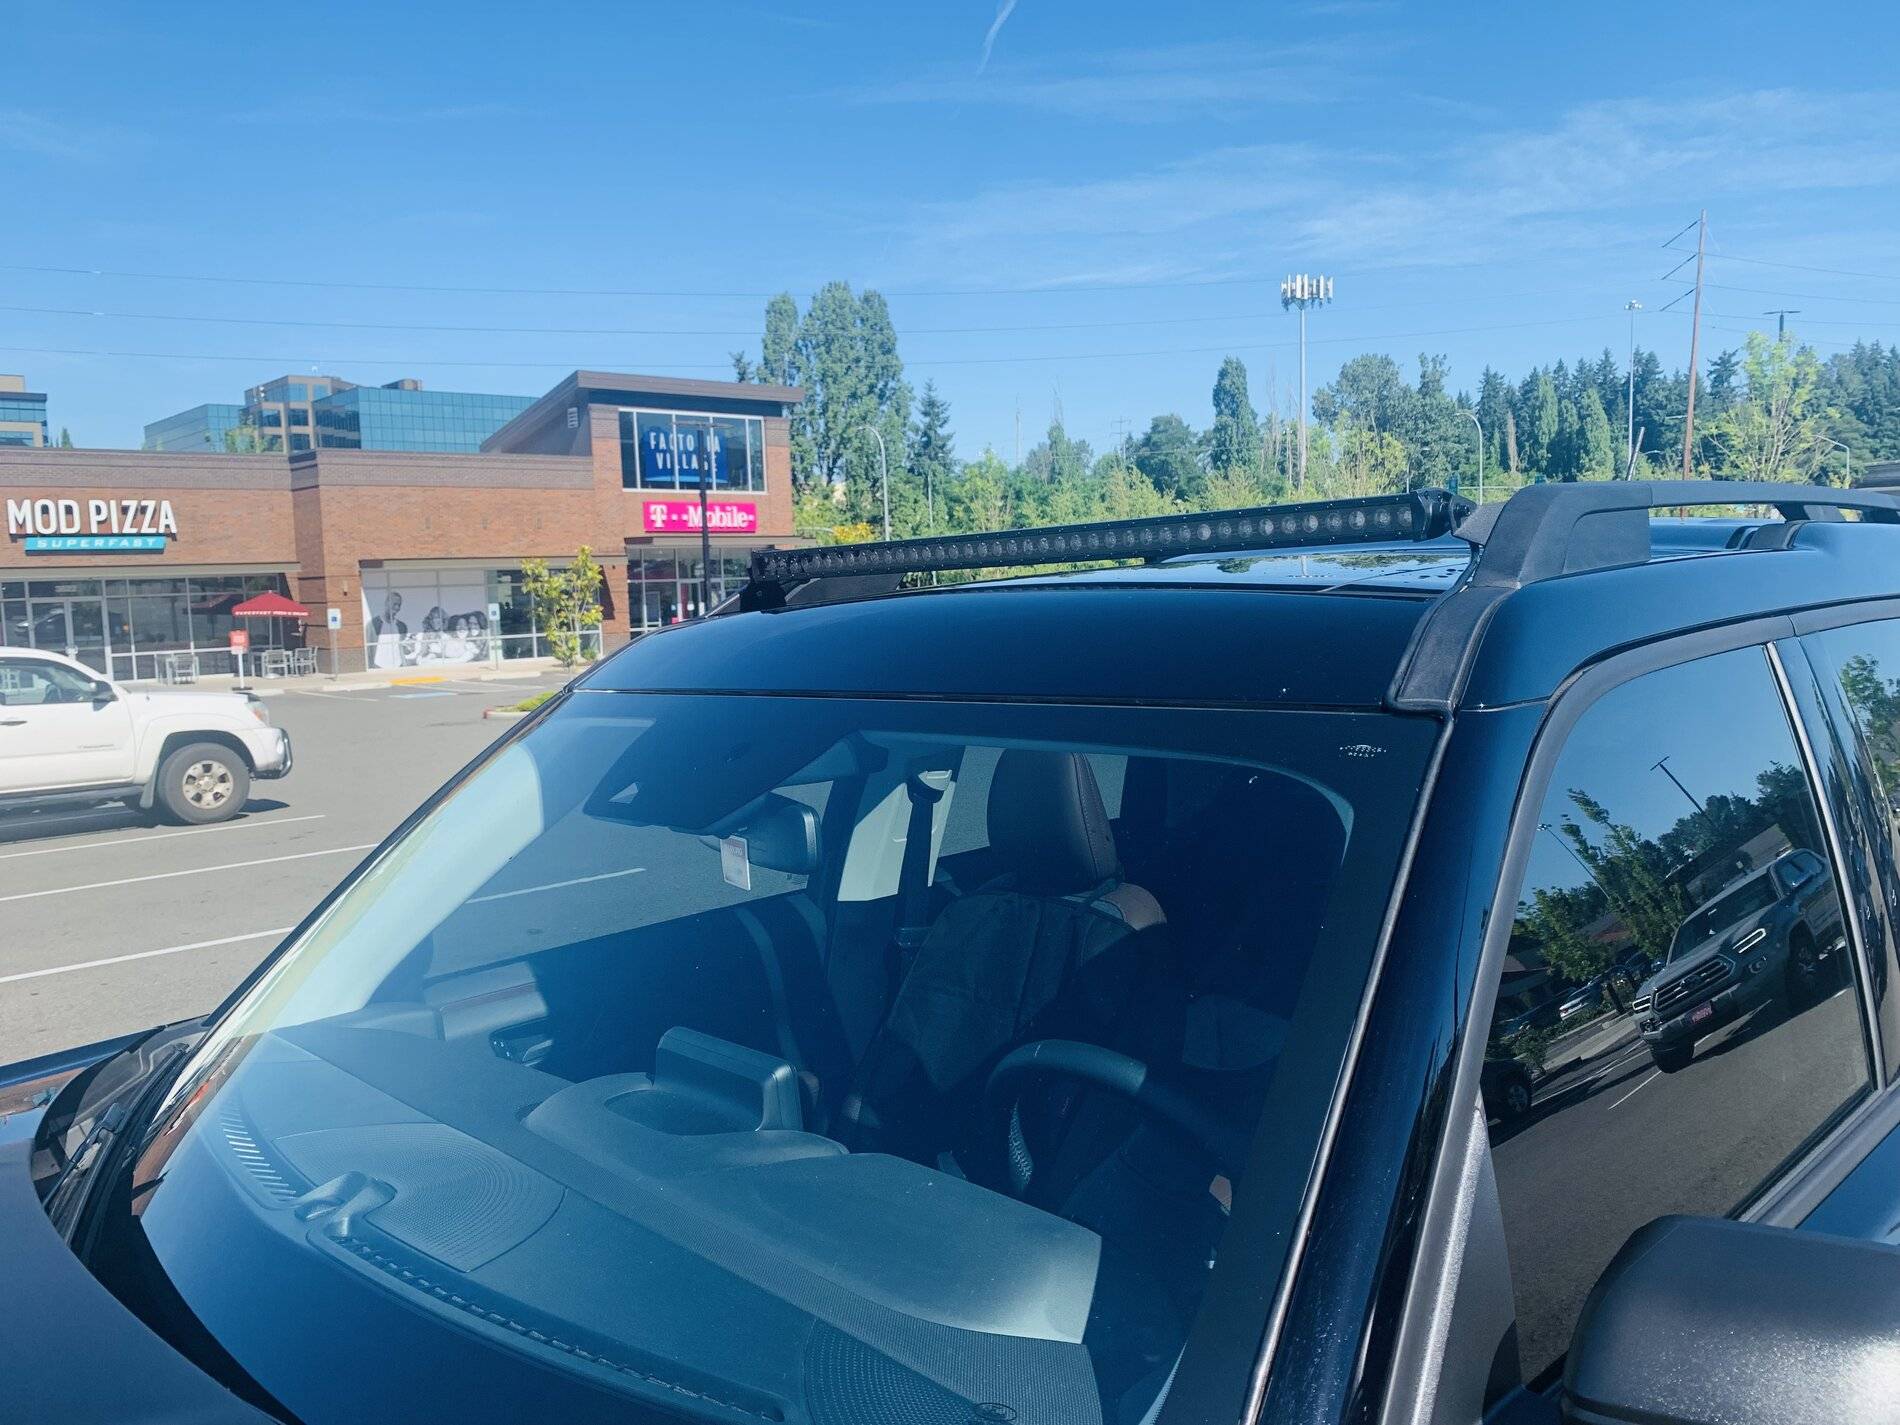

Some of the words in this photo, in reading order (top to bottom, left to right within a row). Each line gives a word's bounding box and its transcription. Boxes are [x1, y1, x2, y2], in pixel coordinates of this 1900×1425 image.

[649, 431, 721, 453] FACTOIA
[6, 498, 81, 534] MOD
[88, 499, 178, 534] PIZZA
[36, 538, 156, 549] SUPERFAST
